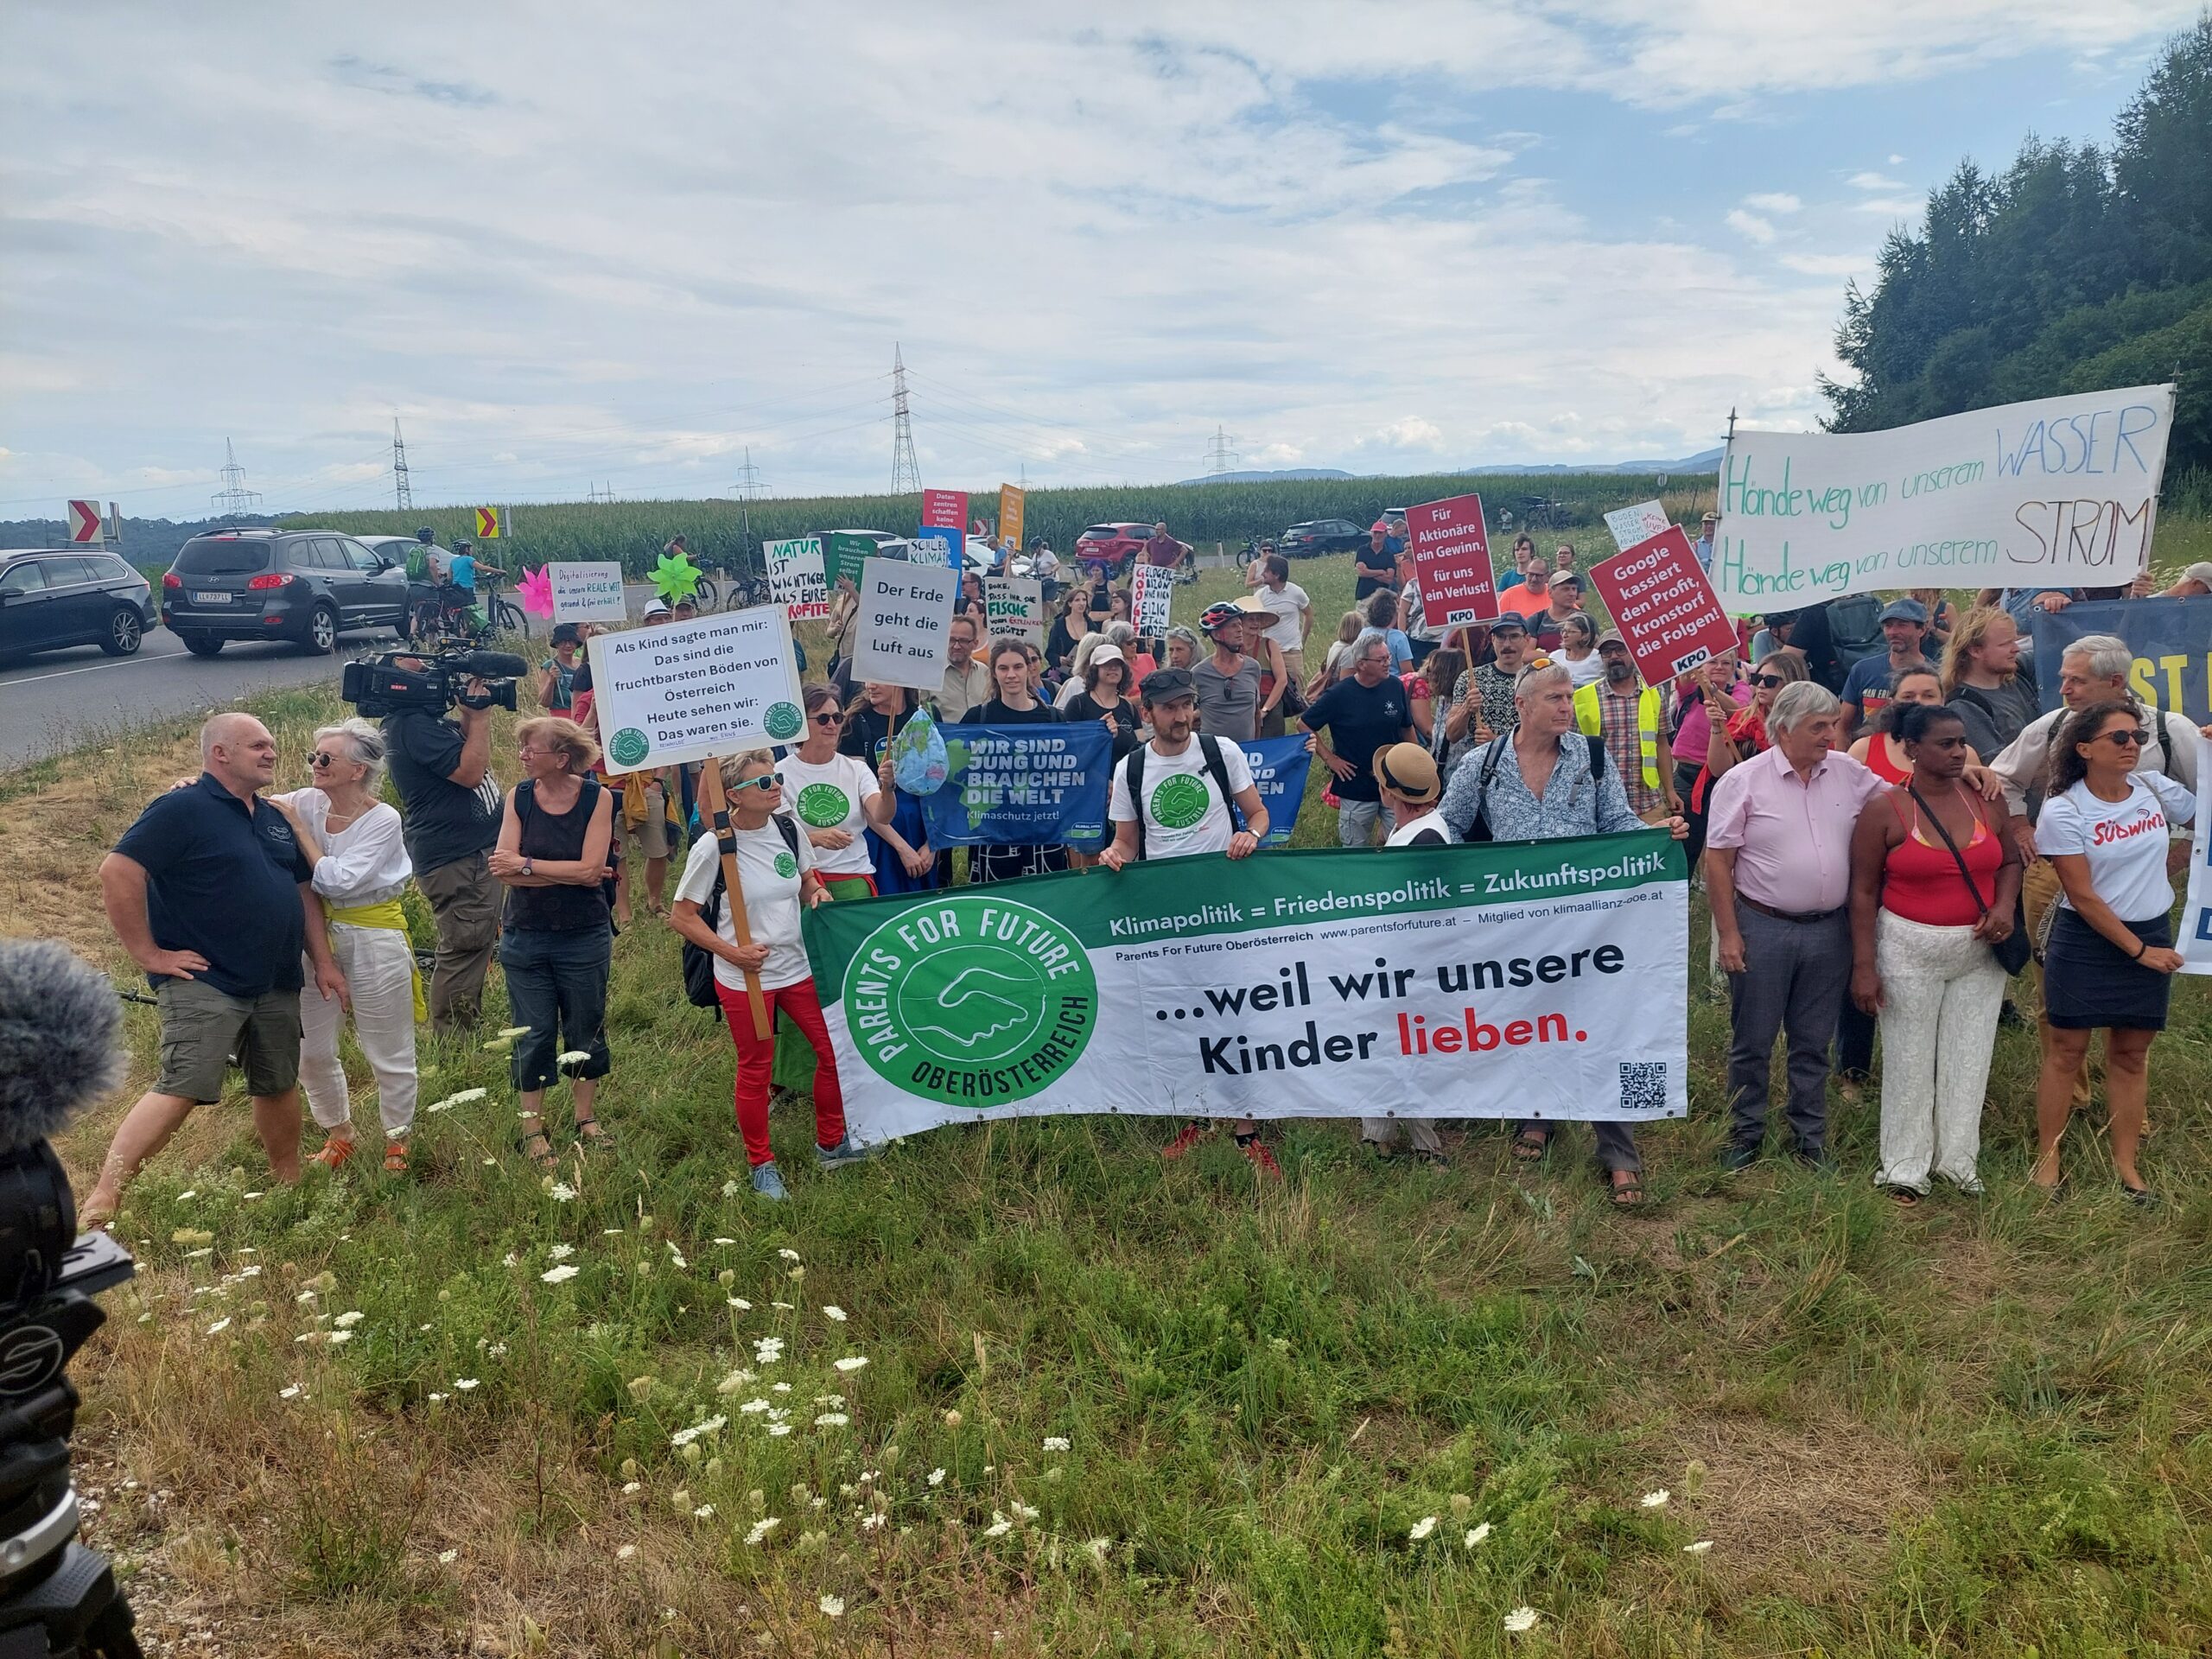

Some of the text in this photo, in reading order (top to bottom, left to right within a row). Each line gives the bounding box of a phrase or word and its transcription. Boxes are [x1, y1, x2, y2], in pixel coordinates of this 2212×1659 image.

[1726, 405, 2158, 530] Hände weg von unserem WASSER
[1432, 508, 1452, 522] Für
[1419, 524, 1476, 543] Aktionäre
[772, 540, 820, 558] NATUR
[838, 545, 868, 556] brauchen
[1416, 542, 1484, 562] ein Gewinn,
[1723, 496, 2150, 595] Hände weg von unserem STROM
[769, 559, 789, 575] IST
[1614, 547, 1670, 581] Google
[772, 572, 826, 589] WICHTIGER
[1433, 567, 1473, 582] für uns
[1619, 562, 1682, 601] kassiert
[587, 582, 607, 593] REALE
[773, 588, 827, 604] ALS EURE
[877, 582, 944, 602] Der Erde
[1426, 581, 1490, 601] ein Verlust!
[1024, 595, 1037, 604] DIE
[1621, 576, 1700, 622] den Profit,
[788, 603, 830, 620] ROFITE
[988, 601, 1028, 618] FISCHE
[1450, 611, 1472, 622] KPÖ
[1631, 591, 1706, 639] Kronstorf
[874, 613, 938, 631] geht die
[990, 626, 1027, 637] SCHÜTZT
[614, 620, 768, 654] Als Kind sagte man mir:
[1637, 607, 1720, 658] die Folgen!
[654, 645, 734, 666] Das sind die
[872, 639, 934, 658] Luft aus
[1676, 650, 1707, 671] KPÖ
[614, 657, 779, 692] fruchtbarsten Böden von
[664, 682, 735, 702] Österreich
[647, 697, 760, 724] Heute sehen wir:
[658, 718, 754, 741] Das waren sie.
[969, 739, 1065, 754] WIR SIND
[968, 754, 1077, 770] JUNG UND
[967, 772, 1085, 787] BRAUCHEN
[808, 785, 821, 794] FOR
[824, 786, 846, 803] FUTURE
[967, 789, 1065, 804] DIE WELT
[1152, 776, 1205, 821] PARENTS FOR FUTURE
[817, 812, 846, 826] AUSTRIA
[967, 810, 1059, 822] Klimaschutz jetzt!
[1175, 806, 1206, 827] AUSTRIA
[2094, 813, 2164, 846] SÜDWIND
[1109, 903, 1244, 937] Klimapolitik
[1274, 877, 1452, 917] Friedenspolitik
[1484, 852, 1666, 893] Zukunftspolitik
[1116, 890, 1662, 962] Parents For Future Oberösterreich www.parentsforfuture.at Mitglied von klimaallianz-ooe.at
[1327, 957, 1414, 1001] wir
[1437, 944, 1624, 994] unsere
[855, 908, 1080, 1065] PARENTS FOR FUTURE
[911, 995, 1089, 1097] OBERÖSTERREICH
[1199, 1007, 1588, 1075] Kinder lieben.
